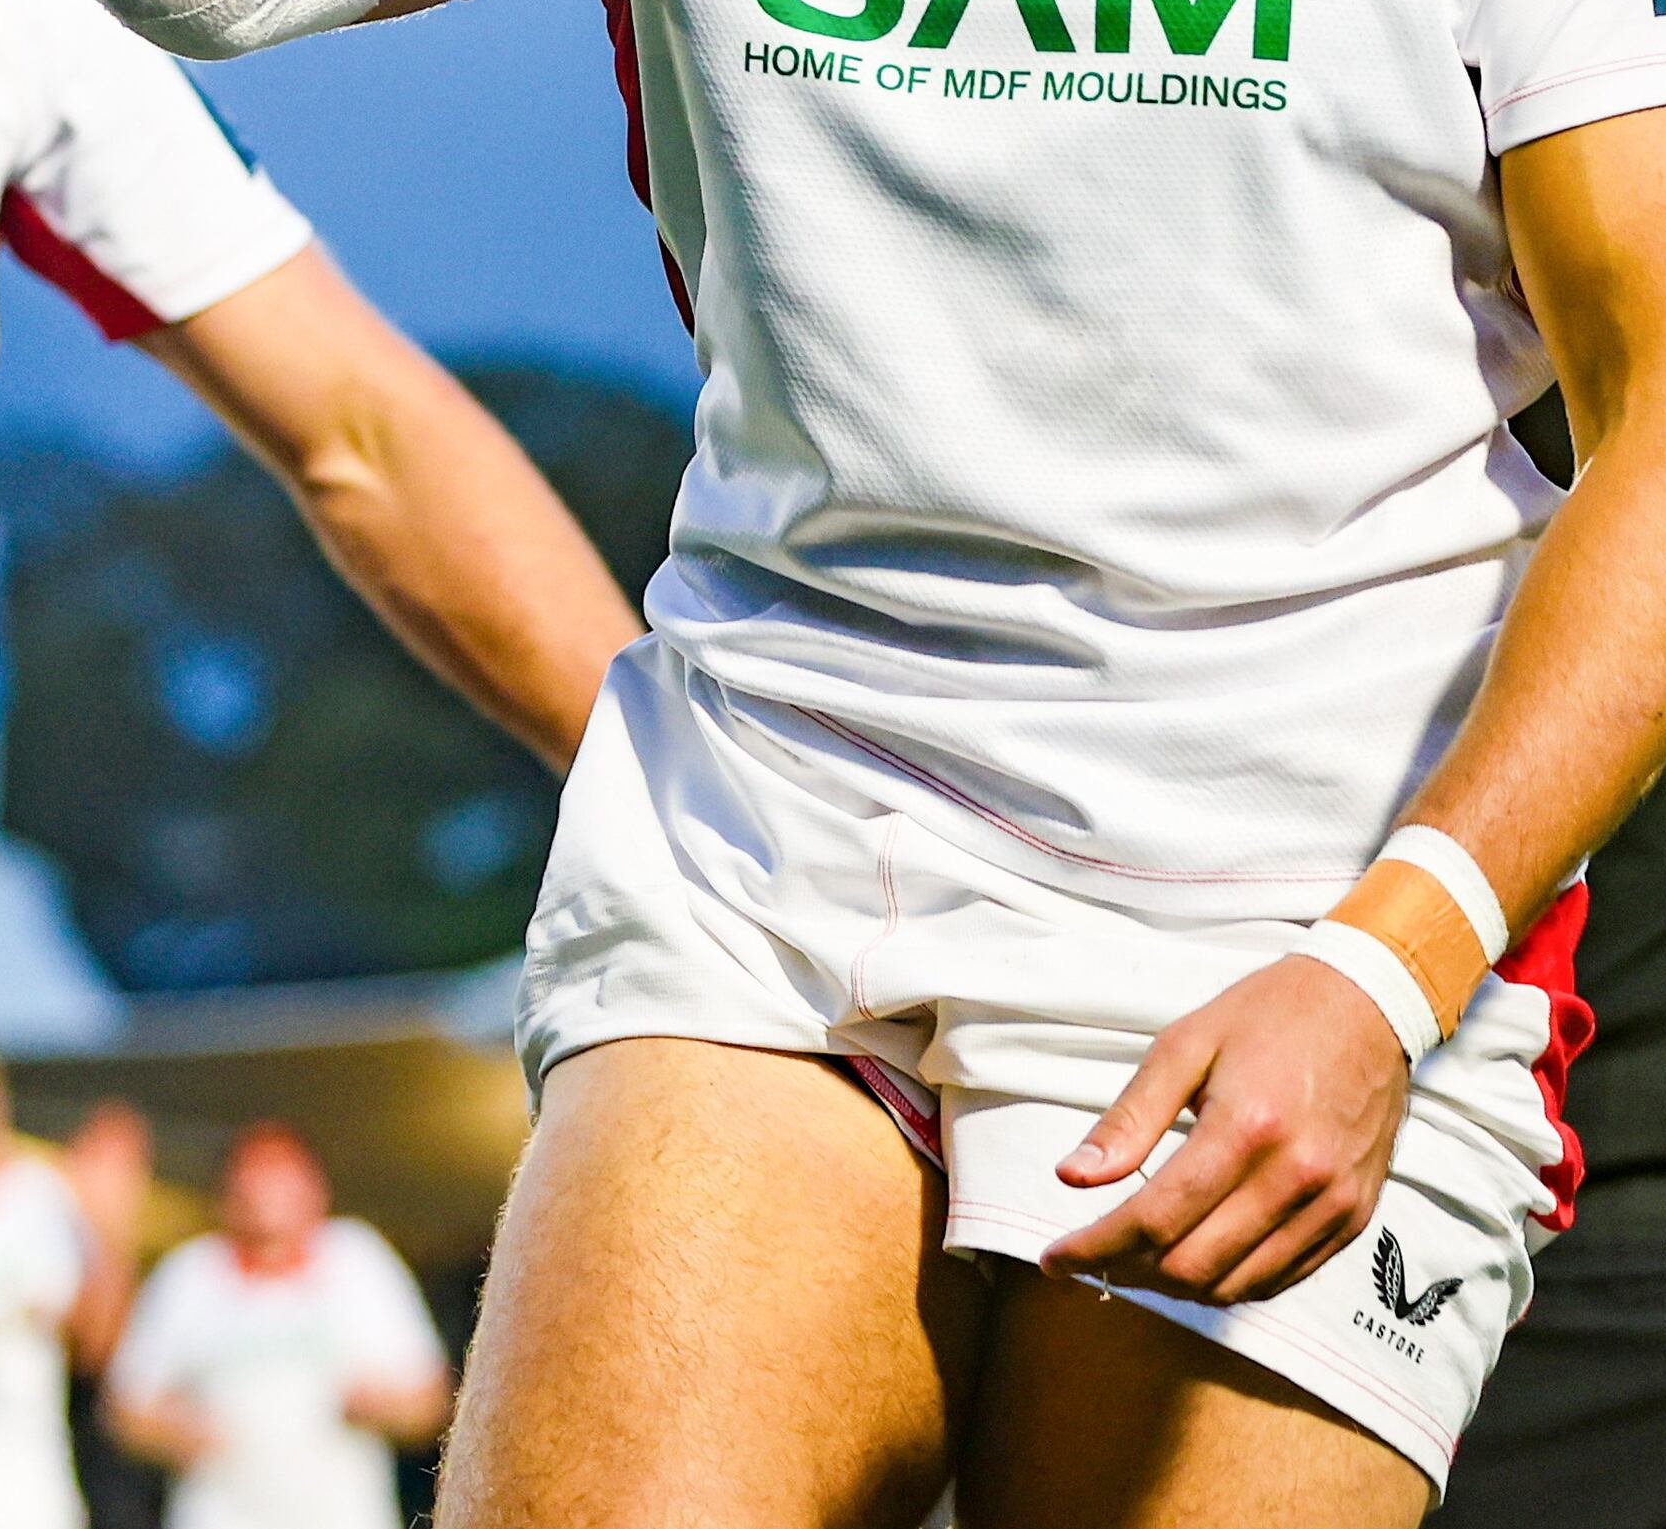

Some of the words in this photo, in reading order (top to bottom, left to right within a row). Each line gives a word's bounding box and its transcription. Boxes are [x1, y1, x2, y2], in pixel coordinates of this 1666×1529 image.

[744, 42, 863, 84] HOME
[876, 62, 928, 95] OF
[945, 69, 1029, 102] MDF
[1042, 72, 1288, 112] MOULDINGS
[1353, 1310, 1425, 1365] CASTORE
